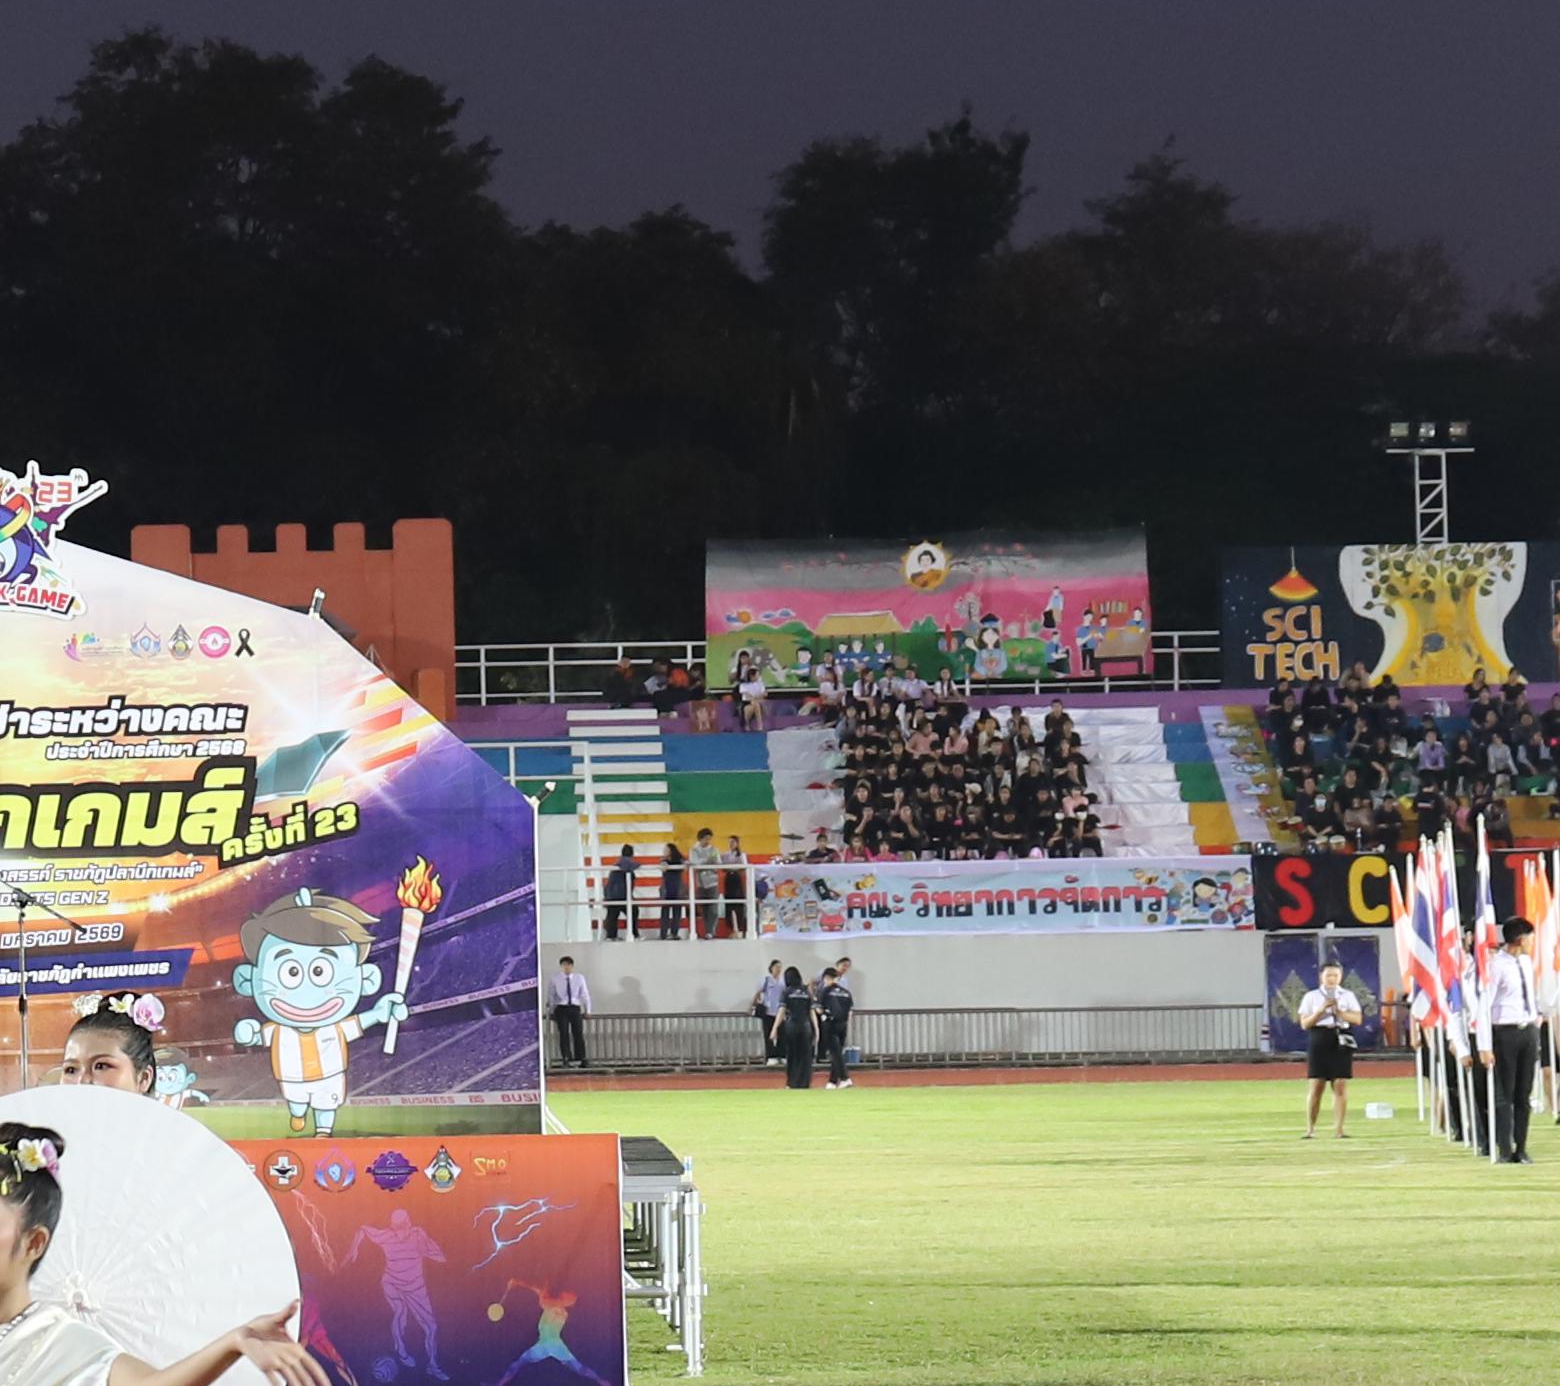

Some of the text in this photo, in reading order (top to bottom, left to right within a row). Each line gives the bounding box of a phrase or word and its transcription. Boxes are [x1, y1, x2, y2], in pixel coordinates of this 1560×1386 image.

[15, 585, 71, 610] GAME
[1262, 604, 1323, 642] SCI
[1246, 641, 1340, 682] TECH
[195, 739, 246, 756] 2568
[221, 802, 358, 862] ครั้งที่ 23
[58, 891, 92, 905] GEN
[95, 890, 109, 904] Z
[77, 923, 123, 944] 2569
[400, 1095, 456, 1105] BUSINESS
